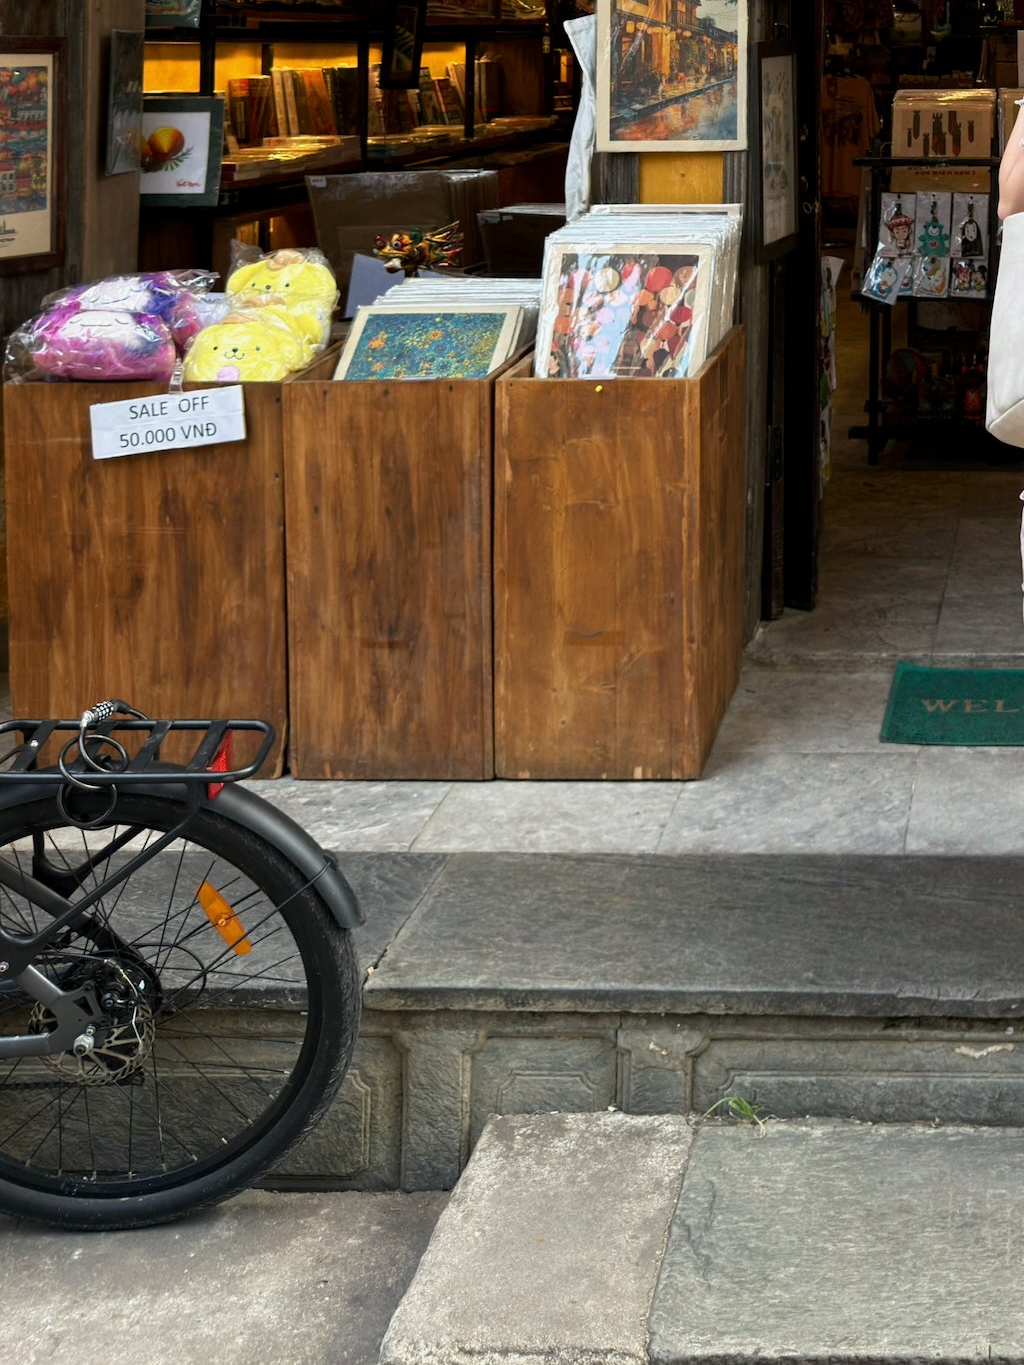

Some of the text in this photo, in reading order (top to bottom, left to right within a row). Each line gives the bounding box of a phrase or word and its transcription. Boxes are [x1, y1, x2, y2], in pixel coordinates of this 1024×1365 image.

[129, 395, 210, 420] SALE OFF
[119, 422, 218, 448] 50.000 VNĐ
